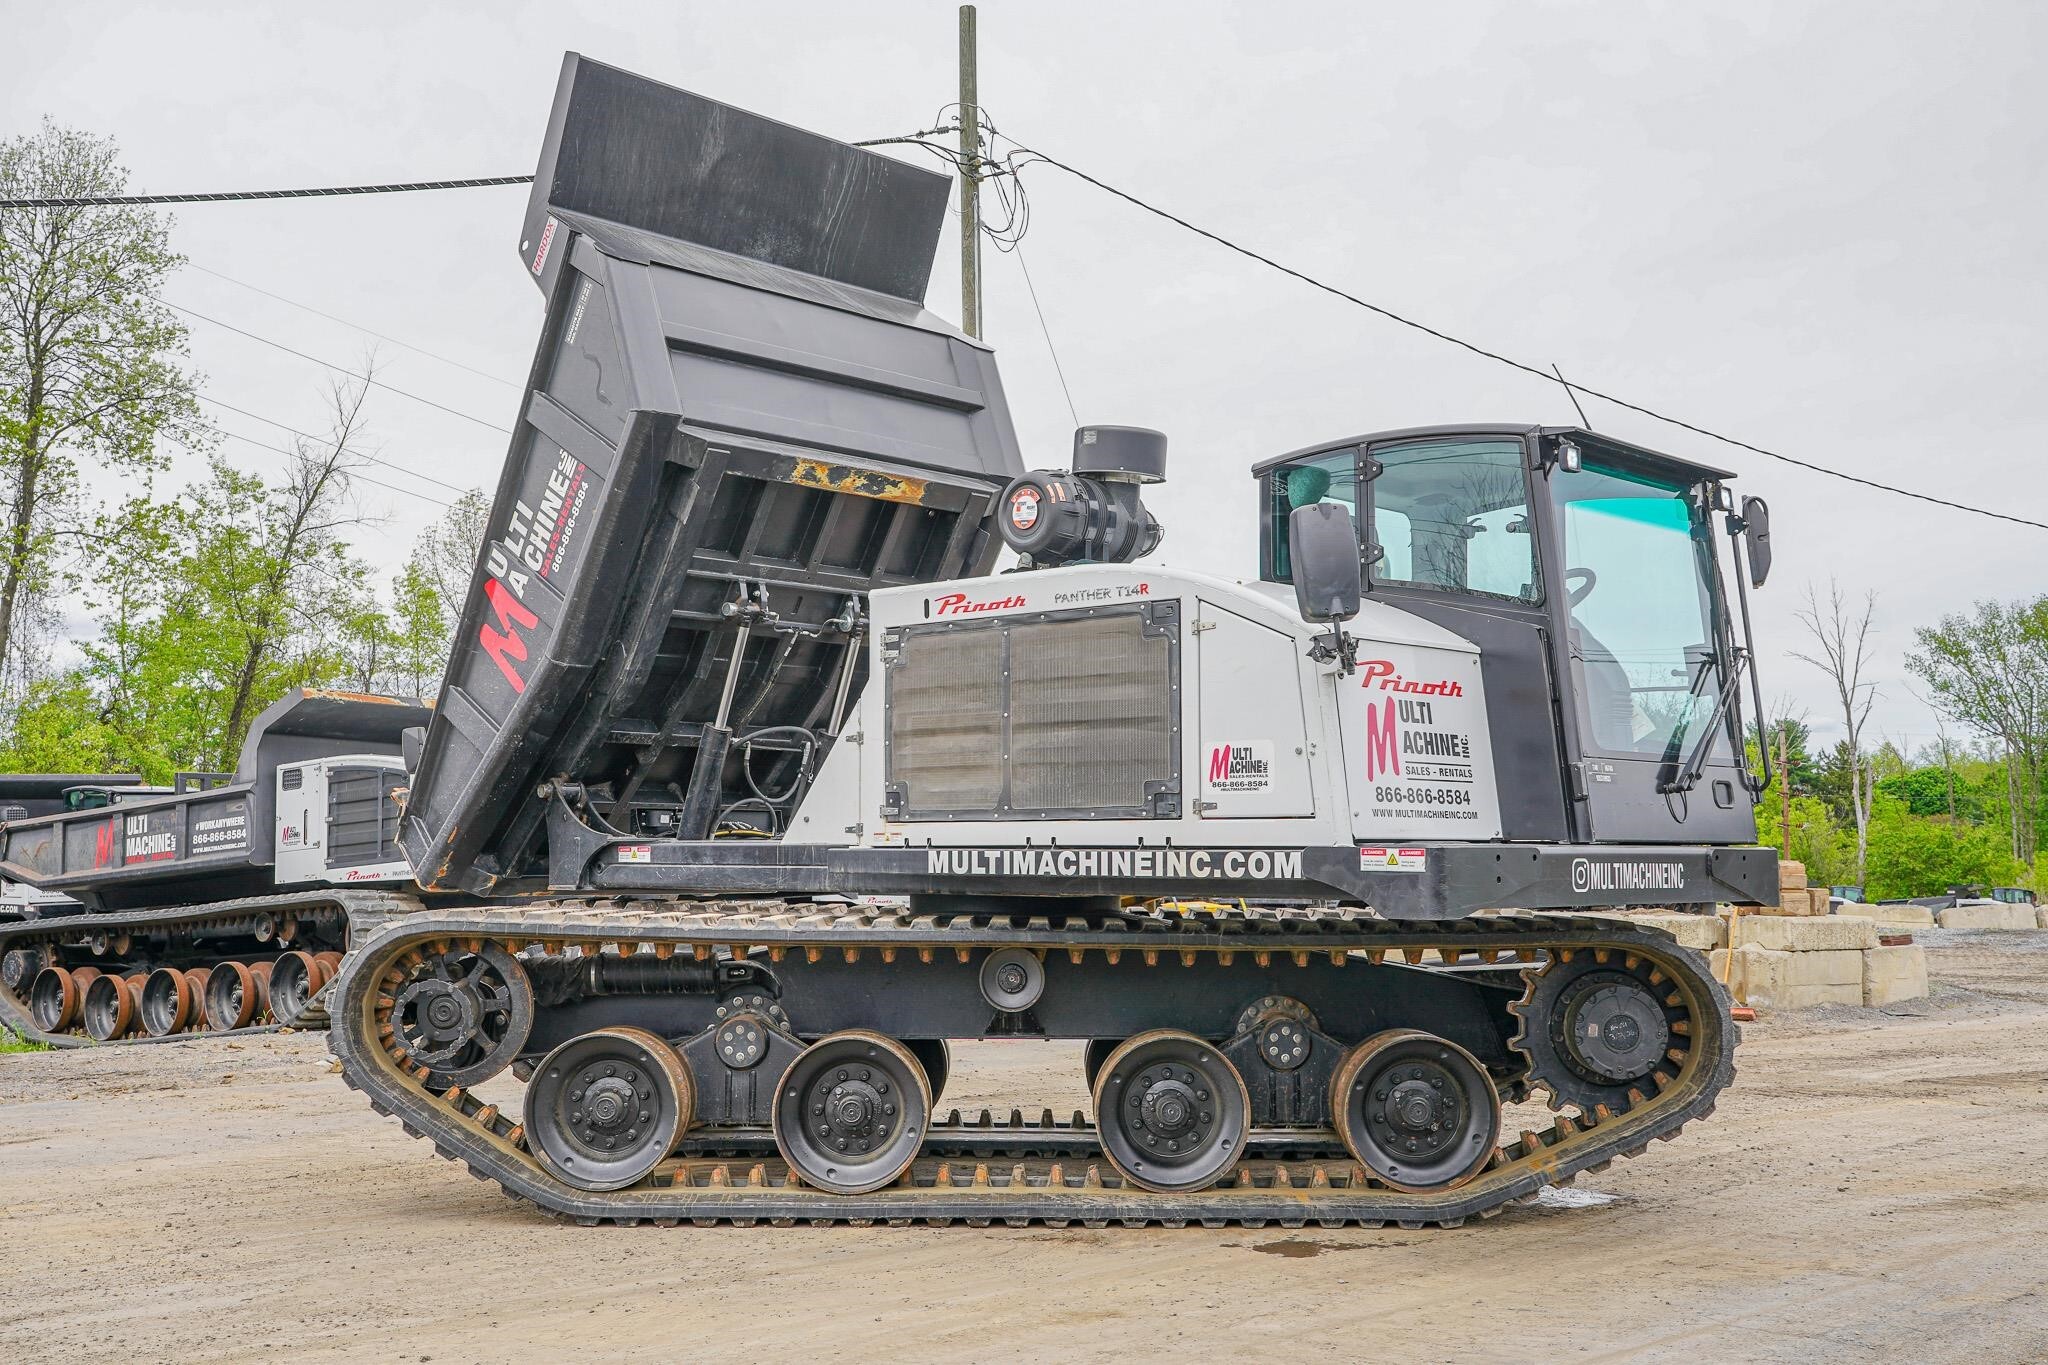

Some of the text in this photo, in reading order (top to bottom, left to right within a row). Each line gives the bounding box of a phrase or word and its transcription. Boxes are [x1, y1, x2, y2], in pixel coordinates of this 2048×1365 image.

[533, 223, 554, 272] HARDOX
[551, 481, 589, 573] 866-866-8584
[934, 583, 1149, 615] Prinoth PANTHER T14R
[1355, 660, 1463, 697] Prinoth
[1212, 780, 1268, 788] 866-866-8584
[1405, 766, 1431, 776] SALES
[1439, 767, 1473, 778] RENTALS
[1375, 786, 1471, 805] 866-866-8584
[192, 829, 246, 845] 866-866-8584
[346, 870, 381, 880] Prinoth
[927, 849, 1302, 879] MULTIMACHINEINC.COM
[1590, 862, 1684, 890] MULTIMACHINEINC
